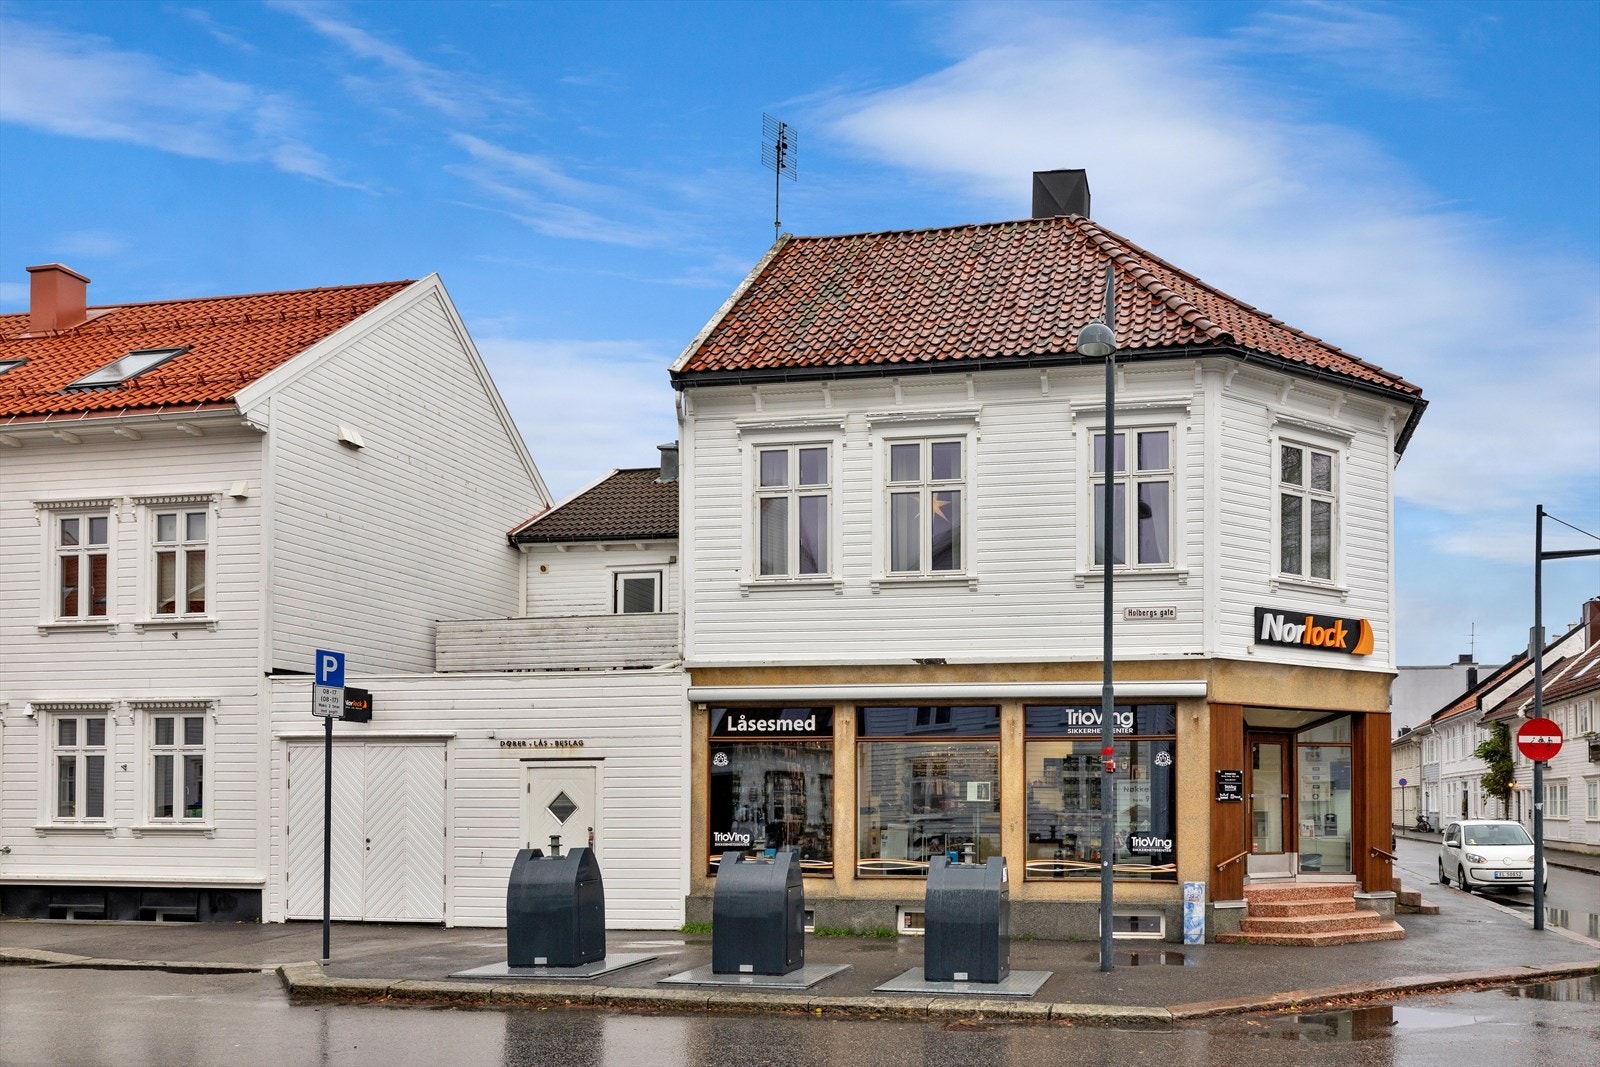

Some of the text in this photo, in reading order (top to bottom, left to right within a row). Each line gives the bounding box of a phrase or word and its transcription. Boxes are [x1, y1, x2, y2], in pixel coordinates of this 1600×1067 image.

[1128, 609, 1174, 618] Holbergs gate
[1260, 613, 1348, 648] Norlock
[322, 655, 338, 682] P
[727, 714, 816, 731] Låsesmed
[1065, 708, 1133, 728] TrioVng
[500, 739, 584, 748] DØRER LÅS BESLAG
[713, 831, 750, 844] TrioVing
[1131, 837, 1172, 849] TrioVing
